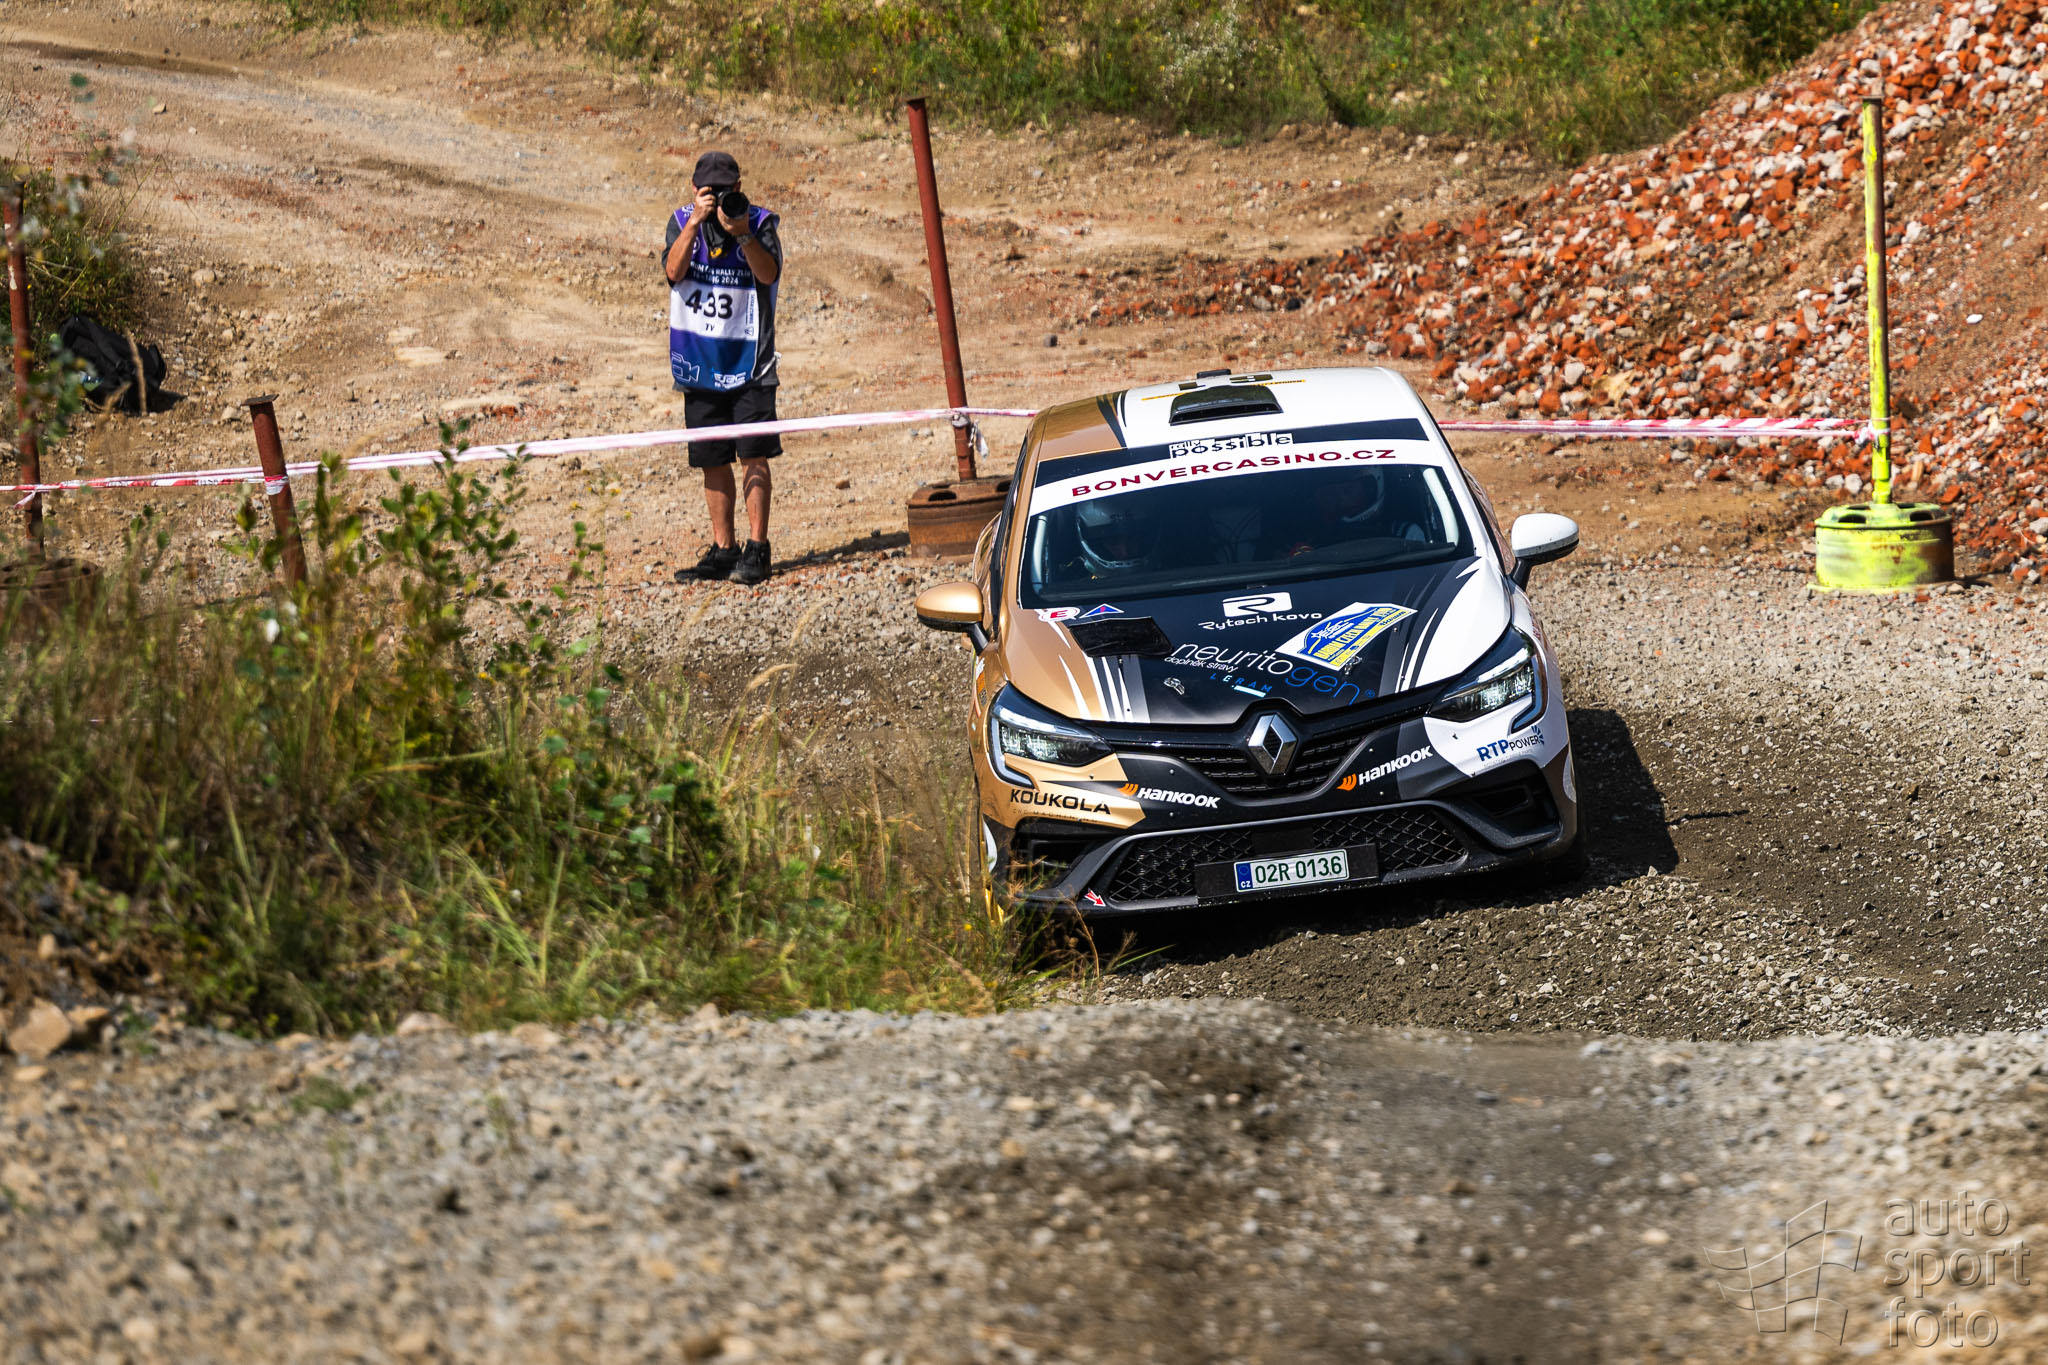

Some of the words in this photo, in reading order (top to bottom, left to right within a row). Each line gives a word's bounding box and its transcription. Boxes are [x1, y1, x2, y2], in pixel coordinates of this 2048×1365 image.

[721, 275, 739, 286] 2024
[685, 289, 733, 320] 433
[1171, 434, 1291, 459] possible
[1072, 449, 1397, 497] BONVERCASINO.CZ
[1198, 614, 1268, 631] Rytech
[1272, 611, 1323, 622] kovo
[1170, 643, 1361, 706] neuritogen
[1206, 661, 1239, 673] stravy
[1009, 788, 1111, 815] KOUKOLA
[1254, 863, 1290, 884] 02R
[1295, 855, 1342, 879] 0136
[1240, 880, 1251, 888] CZ
